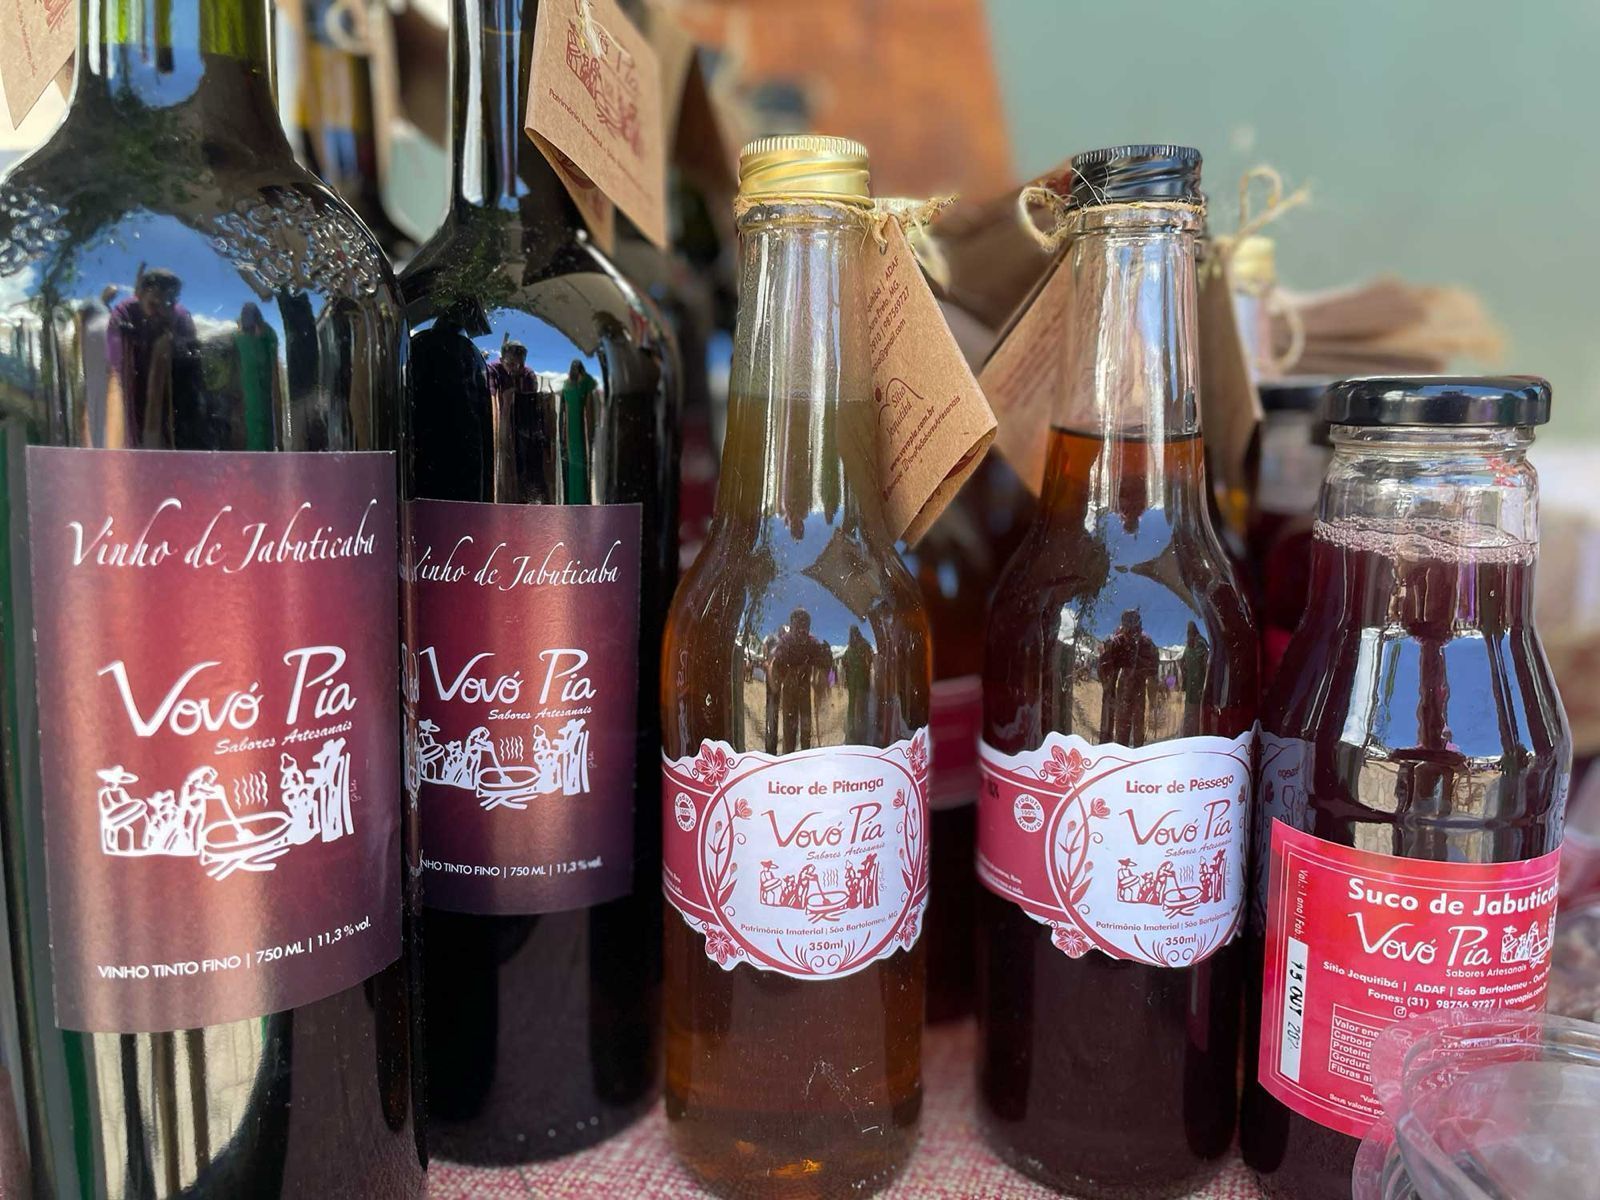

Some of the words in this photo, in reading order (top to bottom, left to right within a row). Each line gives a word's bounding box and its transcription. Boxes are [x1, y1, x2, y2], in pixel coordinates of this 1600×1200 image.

[884, 255, 900, 281] ADAF
[65, 498, 181, 566] Vinho
[184, 506, 232, 569] de
[223, 498, 378, 574] Jabuticaba
[474, 542, 507, 586] de
[498, 540, 622, 591] Jabuticaba
[419, 646, 524, 704] Vovó
[539, 648, 597, 705] Pia
[97, 661, 264, 737] Vovó
[283, 645, 357, 725] Pia
[488, 709, 531, 720] Sabores
[535, 705, 592, 719] Artesanais
[214, 736, 276, 755] Sabores
[281, 721, 352, 746] Artesanais
[768, 781, 803, 795] Licor
[808, 781, 828, 795] de
[833, 777, 884, 794] Pitanga
[1126, 780, 1162, 793] Licor
[1166, 780, 1184, 793] de
[1189, 774, 1234, 791] Pêssego
[1015, 796, 1041, 810] Produto
[760, 809, 845, 848] Vovó
[849, 802, 884, 844] Pia
[1017, 816, 1043, 831] Natural
[1119, 808, 1200, 846] Vovó
[1204, 799, 1232, 840] Pia
[806, 850, 841, 861] Sabores
[1165, 848, 1197, 857] Sabores
[420, 858, 442, 871] NHO
[443, 862, 472, 875] TINTO
[474, 866, 501, 877] FINO
[510, 867, 530, 876] 750
[531, 865, 546, 875] ML
[556, 861, 576, 874] 11,3
[1348, 878, 1418, 911] Suco
[1429, 893, 1465, 915] de
[740, 923, 784, 935] Patrimônio
[786, 926, 824, 935] Imaterial
[830, 925, 844, 934] São
[888, 911, 898, 920] MG
[1096, 920, 1142, 931] Patrimônio
[1144, 922, 1180, 931] Imaterial
[1184, 920, 1198, 929] São
[809, 939, 844, 951] 350ml
[1165, 933, 1197, 946] 350ml
[1347, 912, 1439, 965] Vovó
[1448, 925, 1492, 967] Pia
[98, 964, 149, 979] VINHO
[152, 961, 199, 978] TINTO
[202, 955, 241, 973] FINO
[256, 947, 282, 964] 750
[285, 941, 305, 957] ML
[1323, 961, 1345, 975] Sítio
[1414, 983, 1446, 994] ADAF
[1457, 986, 1476, 996] São
[1480, 981, 1528, 995] Bartolomeu
[1445, 968, 1484, 978] Sabores
[1487, 964, 1527, 977] Artesanais
[1368, 988, 1403, 1004] Fones:
[1407, 996, 1429, 1008] (31)
[1436, 1000, 1469, 1009] 98756
[1472, 999, 1496, 1009] 9727
[1334, 1018, 1359, 1032] Valor
[1360, 1027, 1380, 1038] ene
[1333, 1030, 1372, 1048] Carboid
[1332, 1051, 1371, 1069] Gordura
[1331, 1062, 1361, 1079] Fibras
